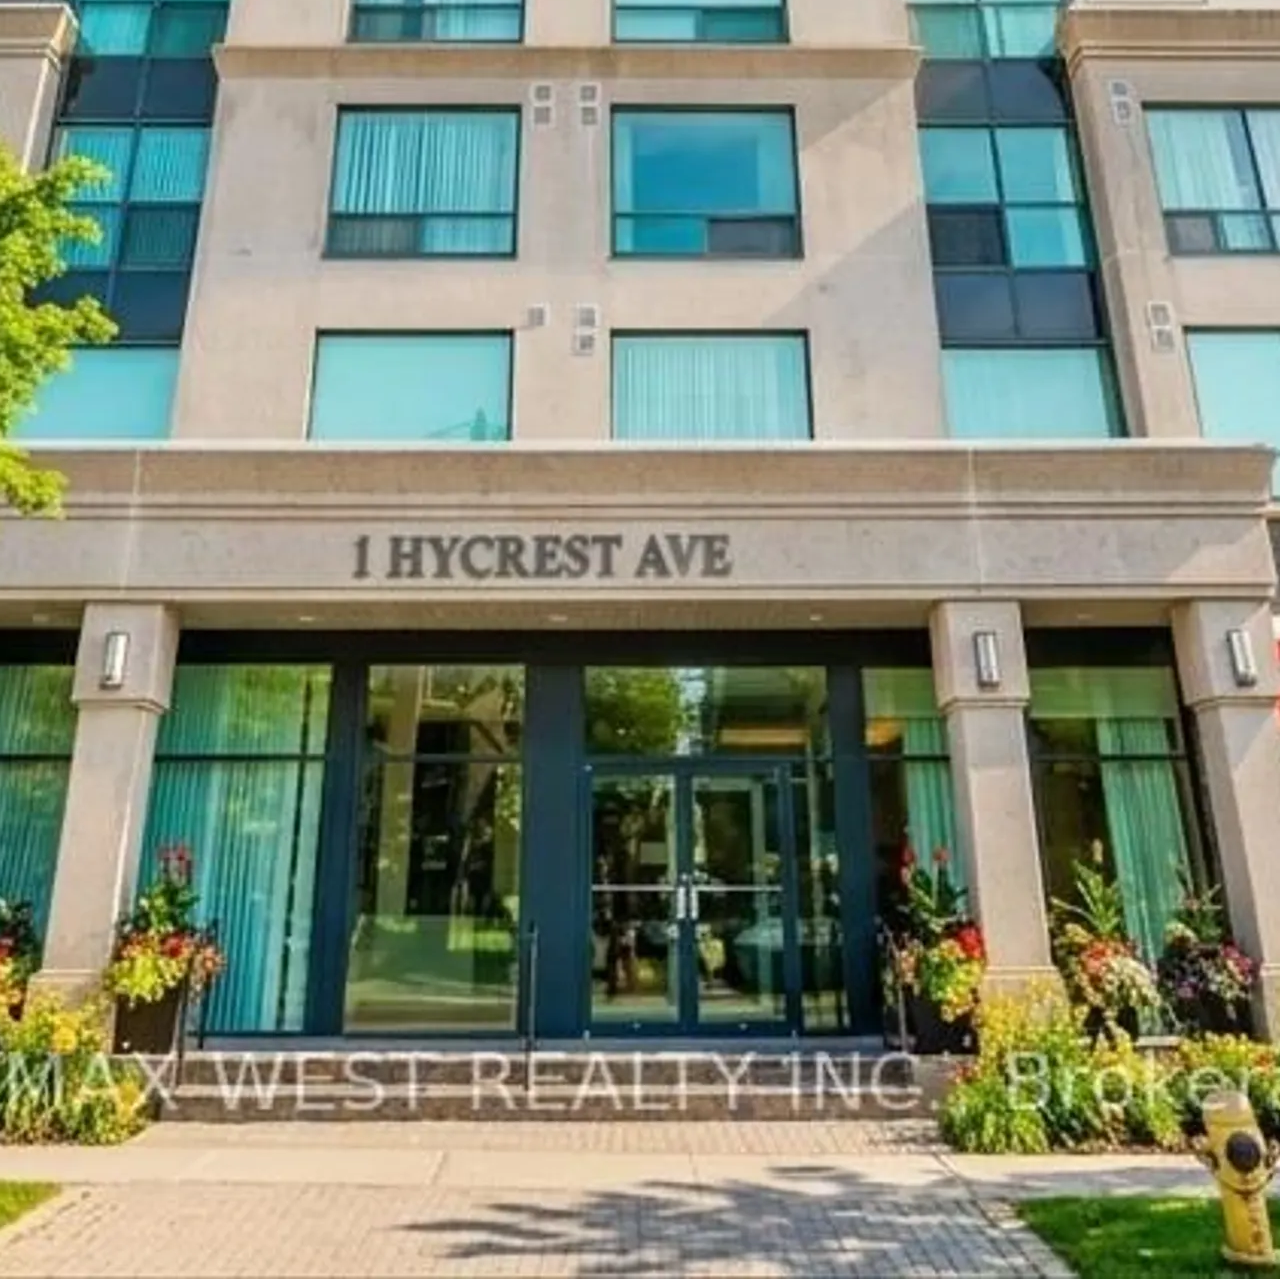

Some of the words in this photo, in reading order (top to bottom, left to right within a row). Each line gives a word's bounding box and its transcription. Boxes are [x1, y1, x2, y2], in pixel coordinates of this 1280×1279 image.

[352, 534, 370, 579] 1
[385, 534, 623, 579] HYCREST
[634, 534, 732, 578] AVE
